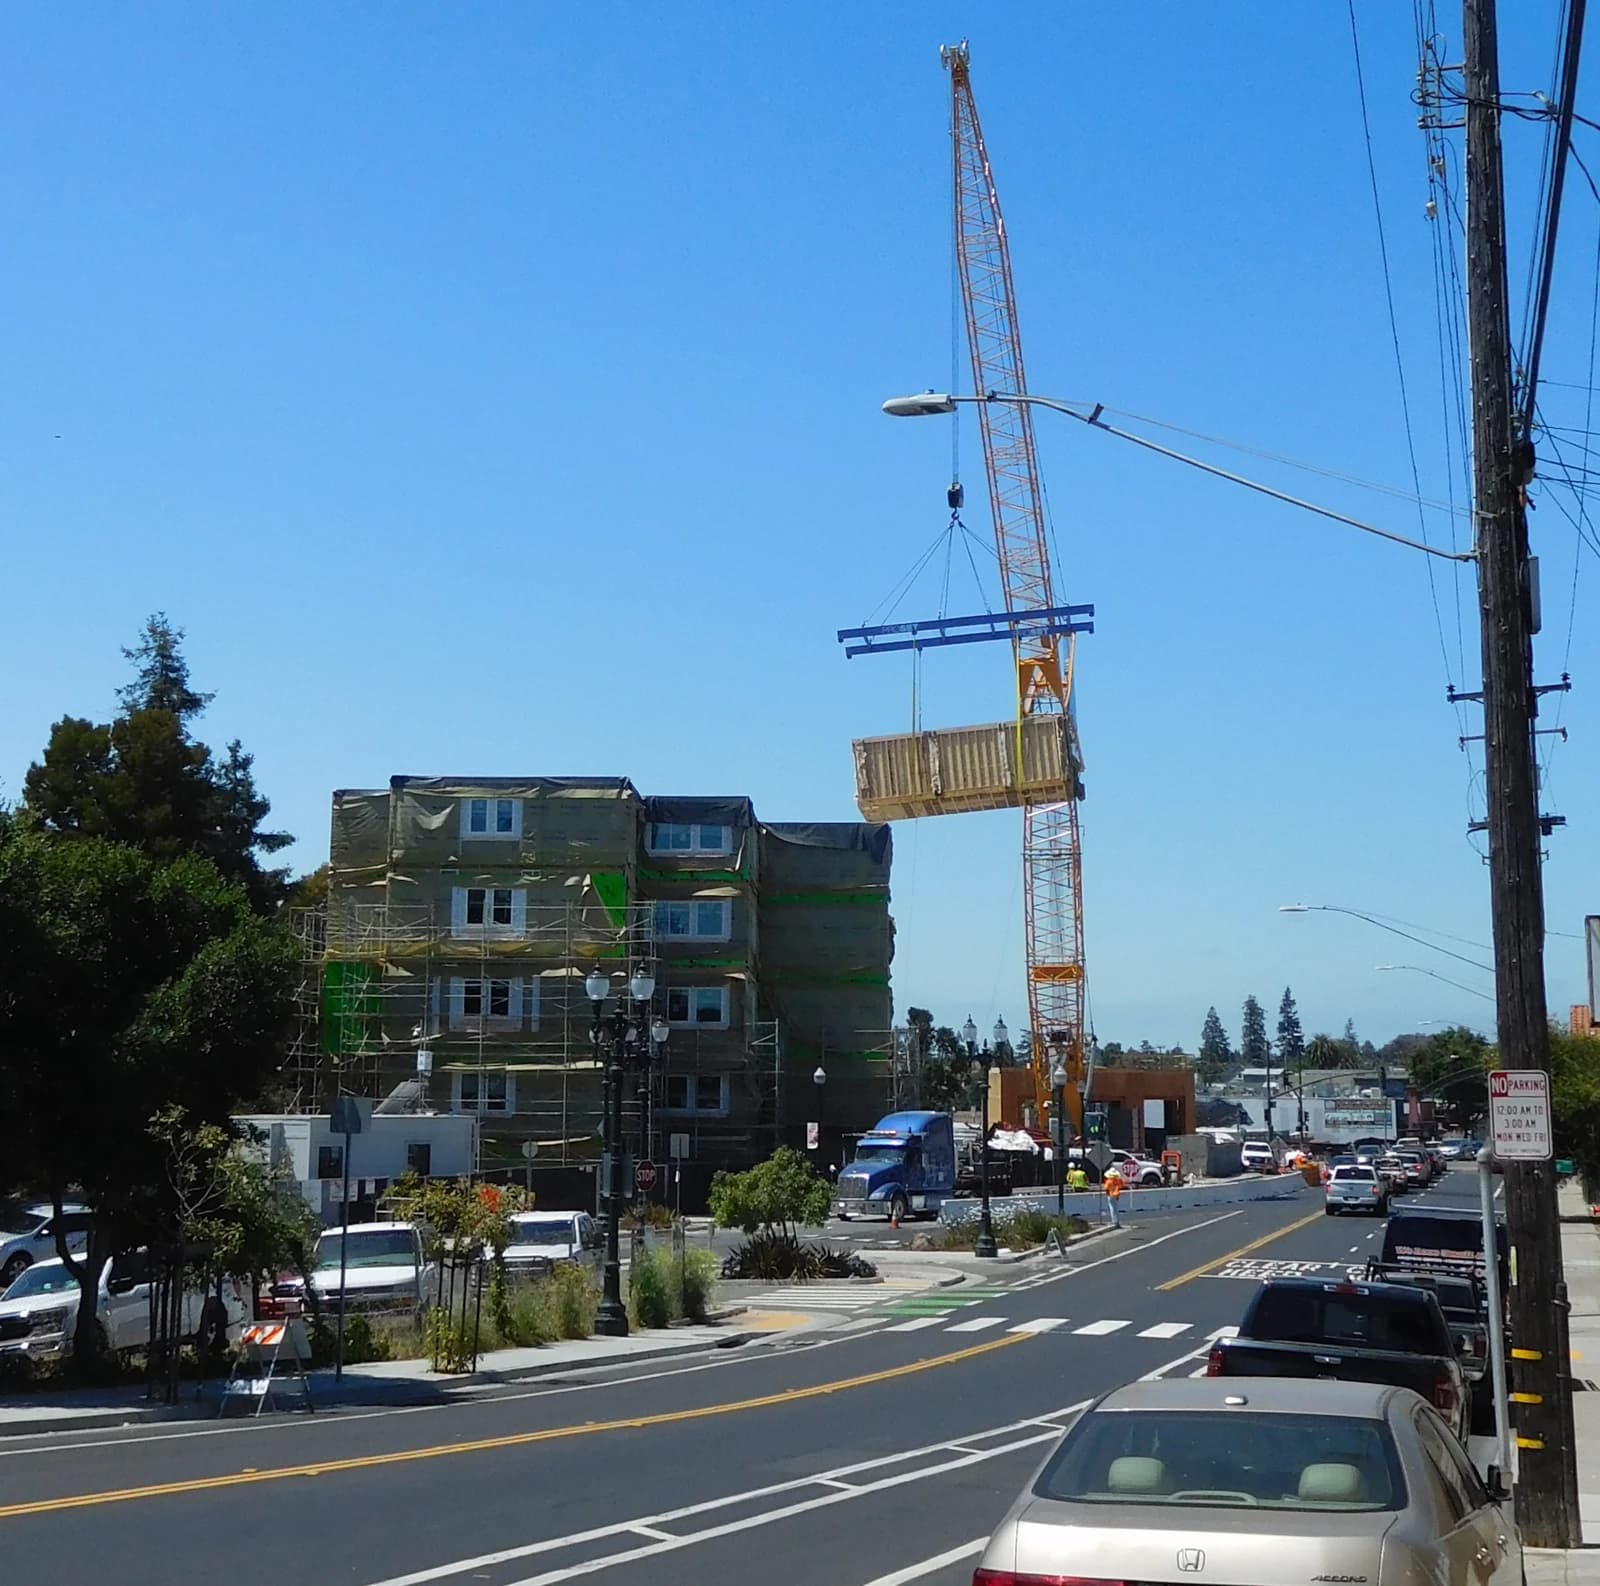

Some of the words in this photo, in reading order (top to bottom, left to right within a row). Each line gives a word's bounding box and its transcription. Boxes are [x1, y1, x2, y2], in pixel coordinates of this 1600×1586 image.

[1491, 1076, 1507, 1093] NO
[1508, 1080, 1545, 1090] PARKING
[1534, 1105, 1544, 1115] TO
[1496, 1133, 1512, 1142] MON
[1516, 1133, 1531, 1142] WED
[637, 1169, 656, 1181] STOP
[1225, 1260, 1322, 1272] CLEAR
[1310, 1575, 1368, 1583] ACCORD
